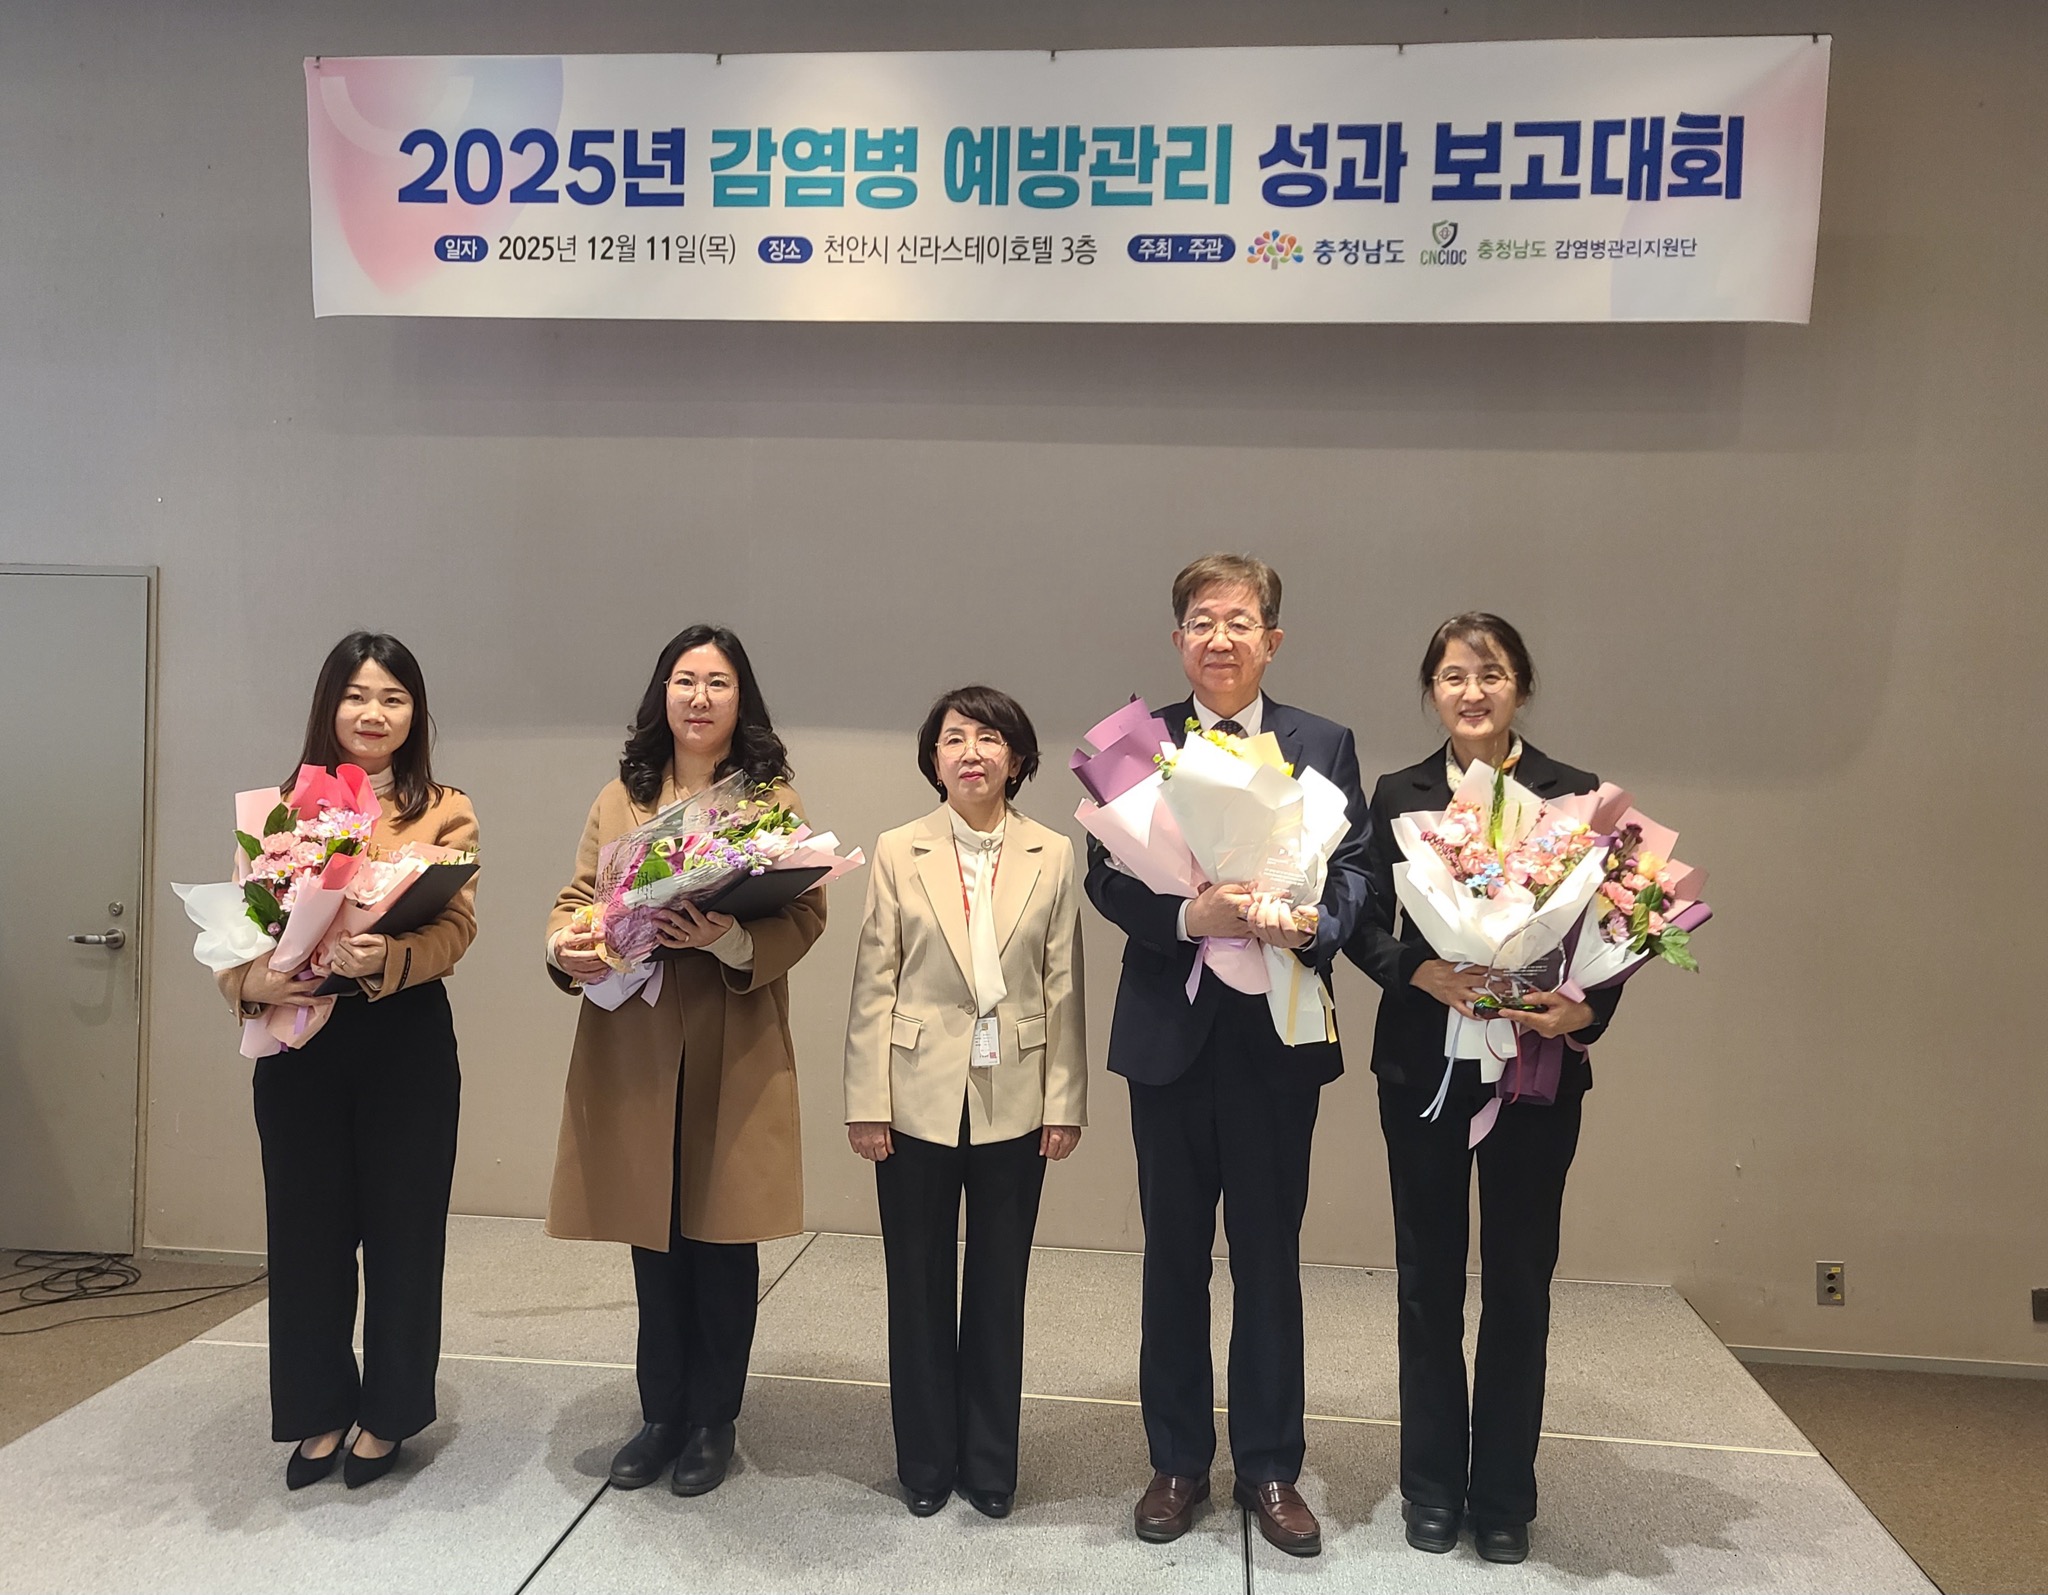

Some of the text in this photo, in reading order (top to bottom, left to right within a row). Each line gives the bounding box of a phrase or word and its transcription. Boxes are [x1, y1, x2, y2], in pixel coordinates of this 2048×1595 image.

[398, 112, 1745, 209] 2025년 감염병 예방관리 성과 보고대회
[444, 238, 478, 260] 일자
[498, 234, 736, 265] 2025년 12월 11일(목)
[767, 239, 802, 262] 장소
[823, 234, 1098, 265] 천안시 신라스테이호텔 3층
[1312, 238, 1406, 266] 충청남도
[1419, 249, 1467, 266] CNCIDC
[1476, 236, 1698, 260] 충청남도 감염병관리지원단
